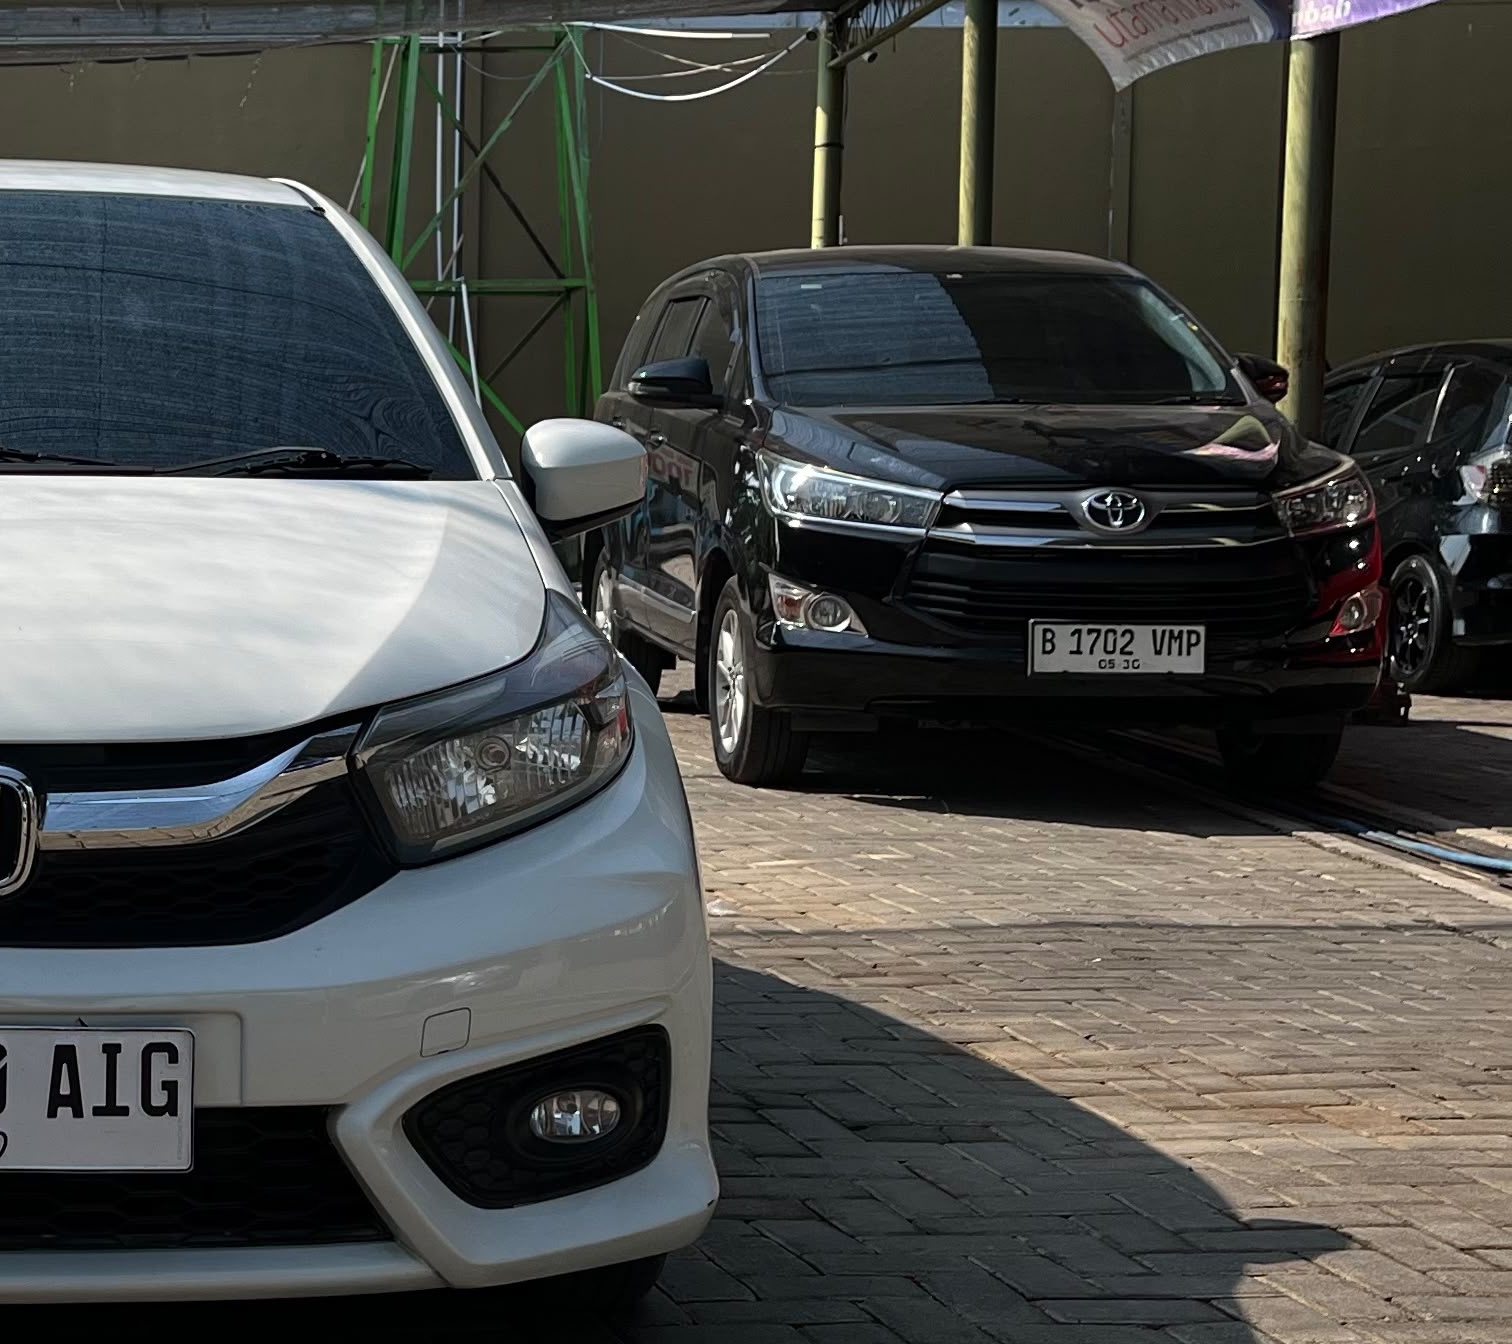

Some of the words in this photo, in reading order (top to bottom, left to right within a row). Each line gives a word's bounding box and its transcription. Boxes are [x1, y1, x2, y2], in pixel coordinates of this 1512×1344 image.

[1042, 627, 1056, 655] B
[1069, 628, 1135, 656] 1702
[1152, 629, 1202, 656] VMP
[46, 1042, 180, 1118] AIG
